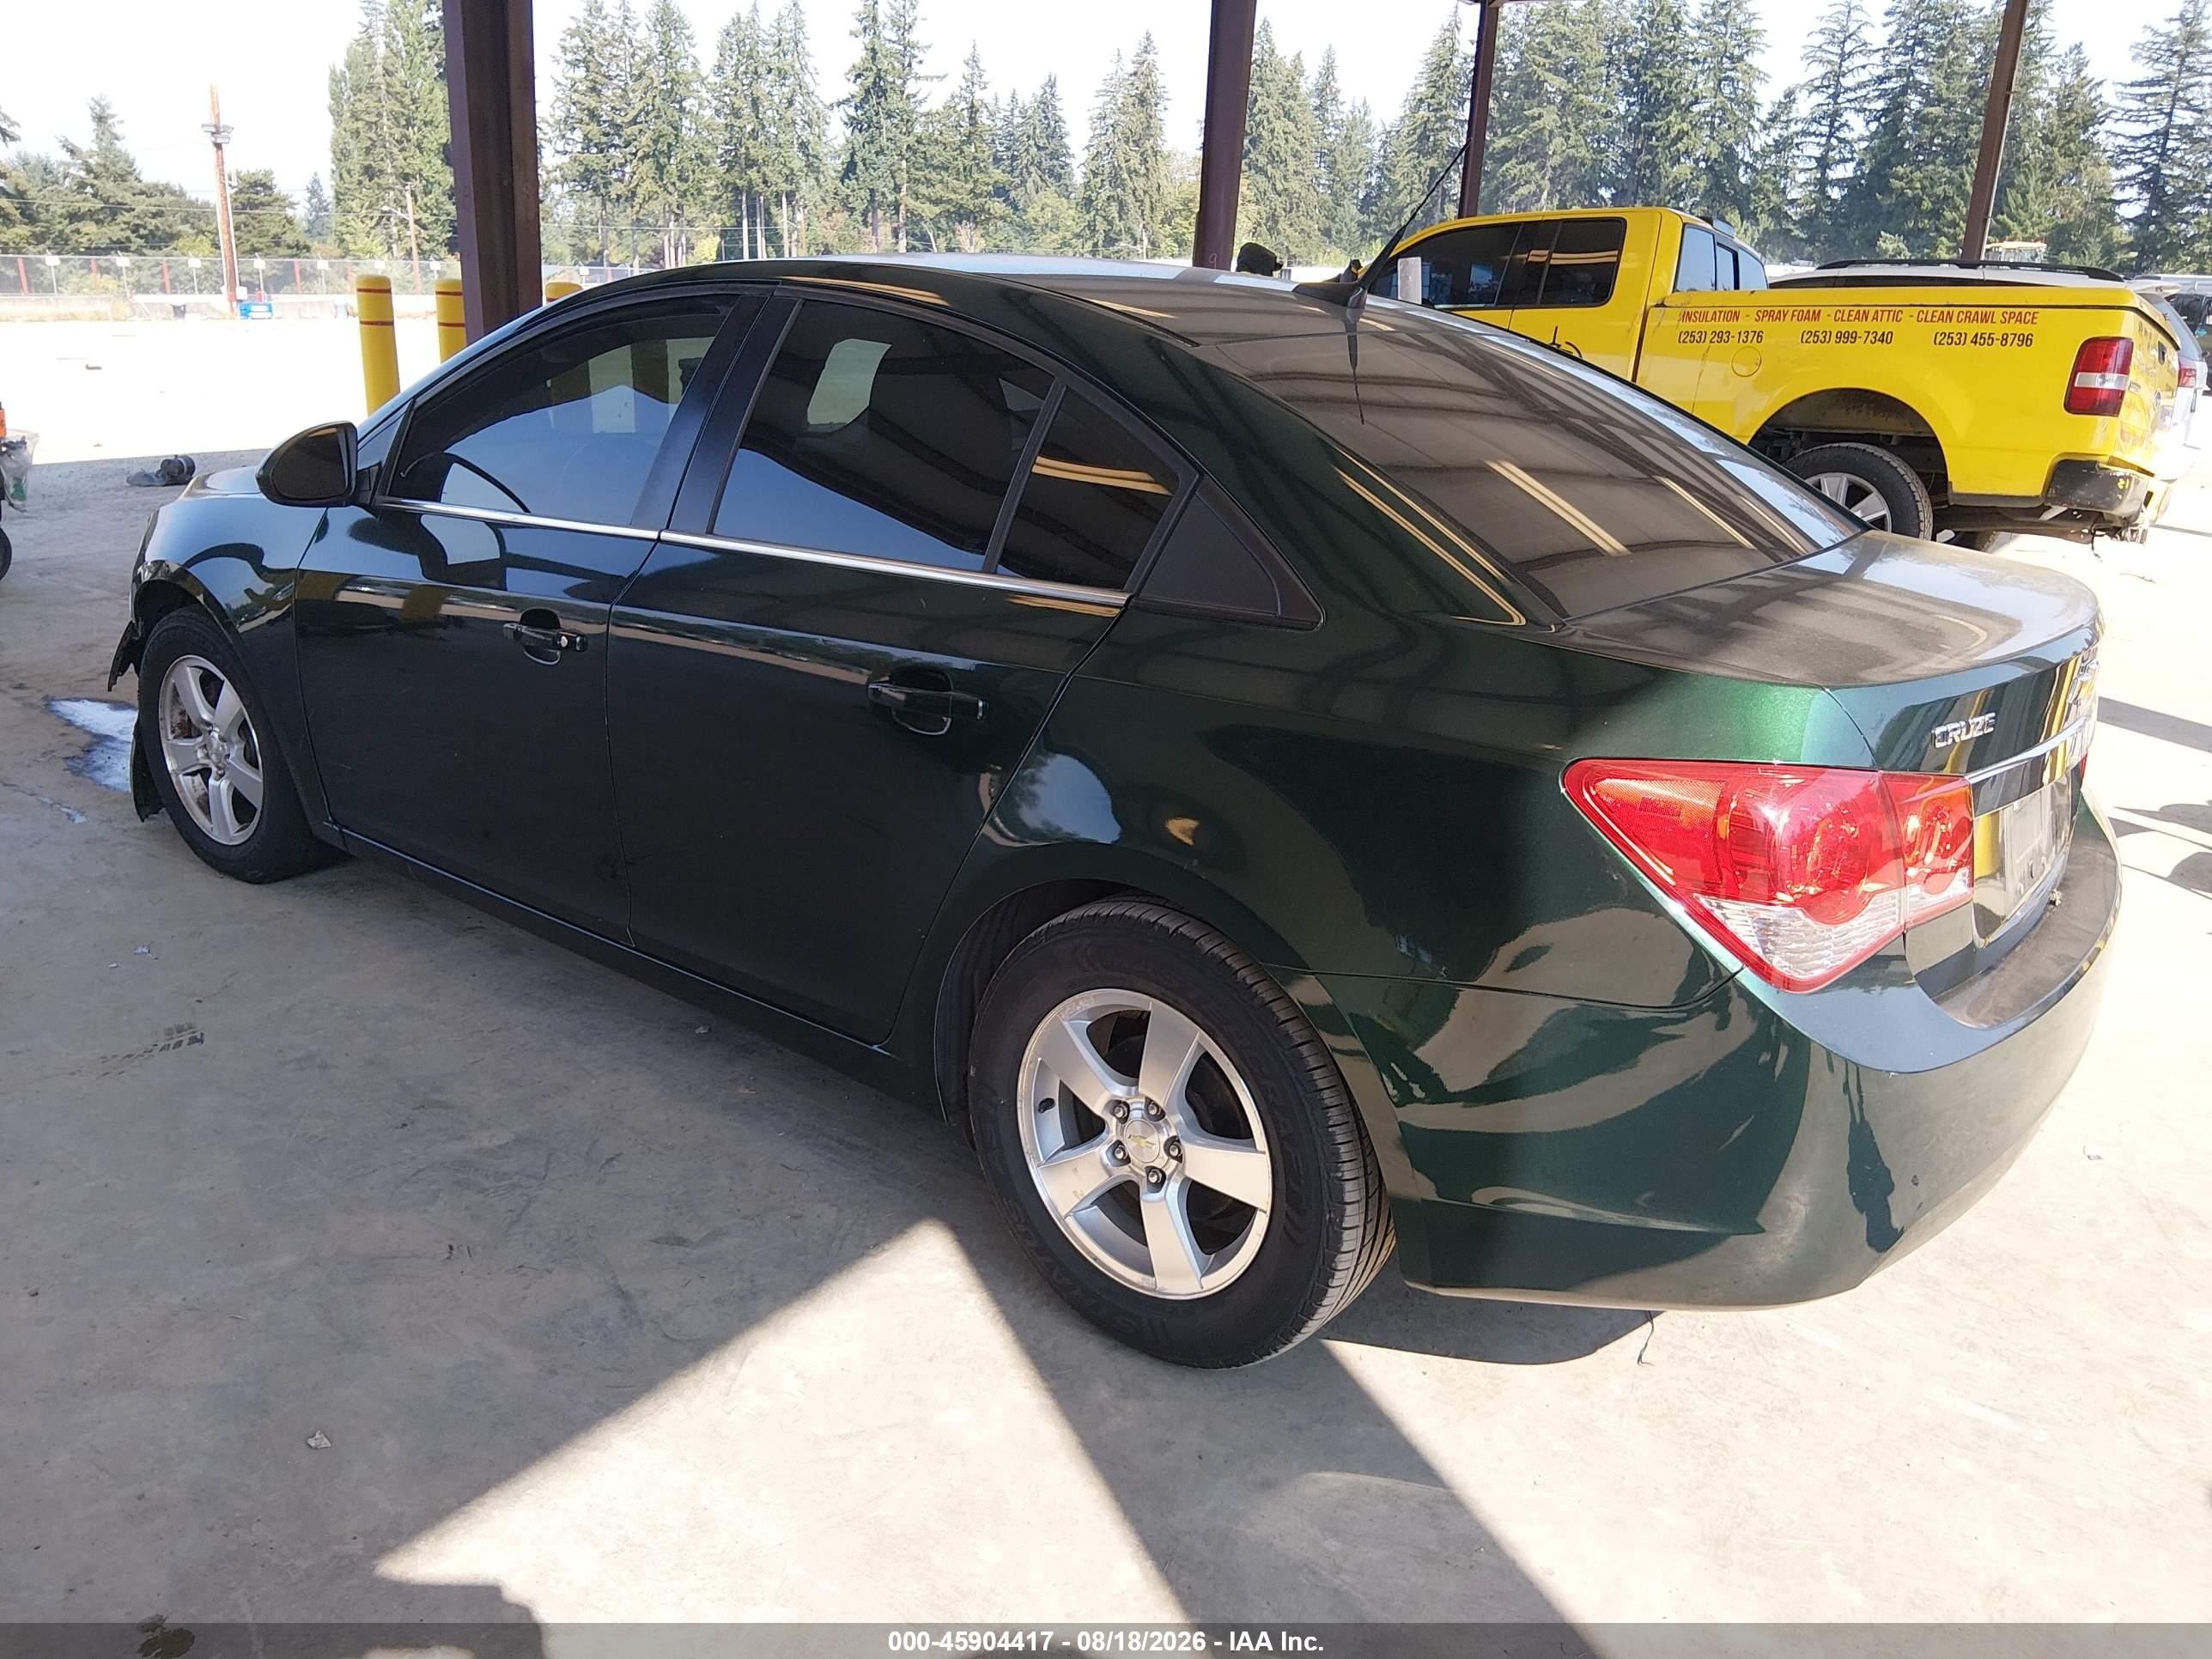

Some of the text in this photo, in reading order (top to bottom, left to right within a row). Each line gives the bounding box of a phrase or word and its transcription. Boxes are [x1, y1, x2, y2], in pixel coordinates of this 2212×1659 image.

[1680, 309, 1741, 323] INSULATION
[1754, 309, 1790, 323] SPRAY
[1791, 309, 1822, 323] FOAM
[1833, 309, 1871, 323] CLEAN
[1871, 309, 1904, 323] ATTIC
[1916, 310, 1954, 324] CLEAN
[1956, 310, 1997, 325] CRAWL
[1999, 311, 2039, 325] SPACE
[1678, 330, 1765, 344] (253) 293-1376
[1800, 330, 1894, 345] (253) 999-7340
[1933, 331, 2034, 348] (253) 455-8796
[1930, 712, 1996, 749] CRUZE
